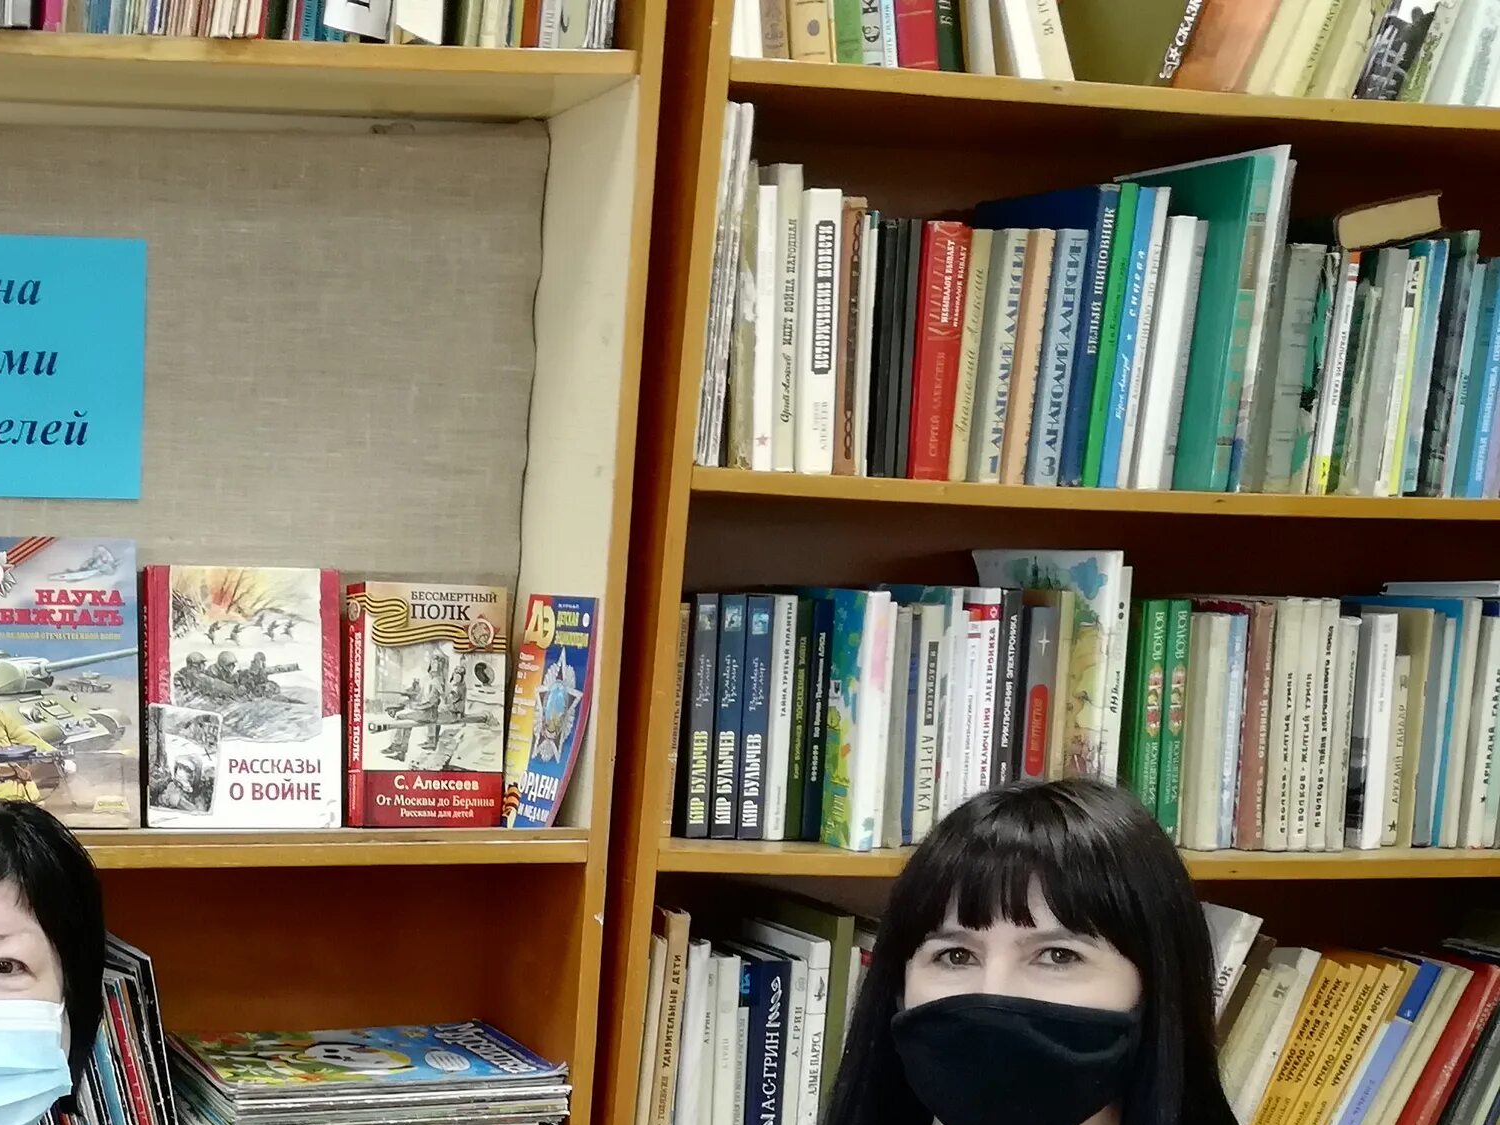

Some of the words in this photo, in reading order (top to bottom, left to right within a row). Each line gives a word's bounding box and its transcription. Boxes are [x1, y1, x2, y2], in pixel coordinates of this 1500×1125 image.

[817, 224, 834, 278] ПОВЕСТИ
[1094, 206, 1116, 296] ШИПОВНИК
[782, 314, 793, 346] ИДЕТ
[813, 281, 832, 370] ИСТОРИЧЕСКИЕ
[990, 341, 1015, 451] АНАТОЛИЙ
[1004, 237, 1028, 338] АЛЕКСИН
[1043, 342, 1071, 453] АНАТОЛИЙ
[1059, 237, 1084, 340] АЛЕКСИН
[1087, 301, 1103, 355] БЕЛЫЙ
[35, 589, 126, 607] НАУКА
[411, 591, 498, 603] БЕССМЕРТНЫЙ
[411, 603, 470, 621] ПОЛК
[556, 611, 580, 627] ДЕТСКАЯ
[525, 599, 556, 649] ДЭ
[784, 601, 794, 647] ПЛАНЕТЫ
[1152, 611, 1165, 662] ВОЛКОВ
[1174, 609, 1188, 660] ВОЛКОВ
[352, 632, 363, 722] БЕССМЕРТНЫЙ
[782, 649, 791, 685] ТРЕТЬЕЙ
[1001, 681, 1013, 748] ПРИКЛЮЧЕНИЯ
[1007, 614, 1019, 680] ЭЛЕКТРОНИКА
[779, 686, 788, 719] ТАЙНА
[979, 706, 991, 788] ПРИКЛЮЧЕНИЯ
[985, 626, 996, 703] ЭЛЕКТРОНИКА
[228, 758, 322, 775] РАССКАЗЫ
[352, 726, 361, 762] ПОЛК
[690, 730, 710, 794] БУЛЫЧЕВ
[716, 729, 736, 794] БУЛЫЧЕВ
[743, 732, 763, 797] БУЛЫЧЕВ
[229, 782, 245, 801] О
[251, 779, 322, 801] ВОЙНЕ
[394, 775, 409, 790] С.
[414, 775, 480, 791] Алексеев
[518, 770, 560, 803] ОРДЕНА
[917, 734, 935, 813] АРТЕМКА
[1391, 753, 1404, 805] АРКАДИЙ
[376, 794, 393, 806] От
[393, 795, 436, 807] Москвы
[437, 797, 450, 808] до
[453, 796, 496, 809] Берлина
[400, 808, 436, 818] Рассказы
[437, 809, 450, 818] для
[451, 809, 474, 819] детей
[689, 796, 706, 826] КИР
[714, 796, 732, 826] КИР
[741, 798, 759, 828] КИР
[671, 954, 682, 985] ДЕТИ
[792, 1006, 803, 1040] ГРИН
[1277, 1049, 1296, 1082] ЧУЧЕЛО
[1296, 1016, 1311, 1042] ТАНЯ
[1284, 1049, 1305, 1082] ЧУЧЕЛО
[1306, 1017, 1322, 1042] ТАНЯ
[1313, 1054, 1335, 1088] ЧУЧЕЛО
[1335, 1021, 1350, 1046] ТАНЯ
[1331, 1053, 1353, 1088] ЧУЧЕЛО
[1353, 1020, 1369, 1045] ТАНЯ
